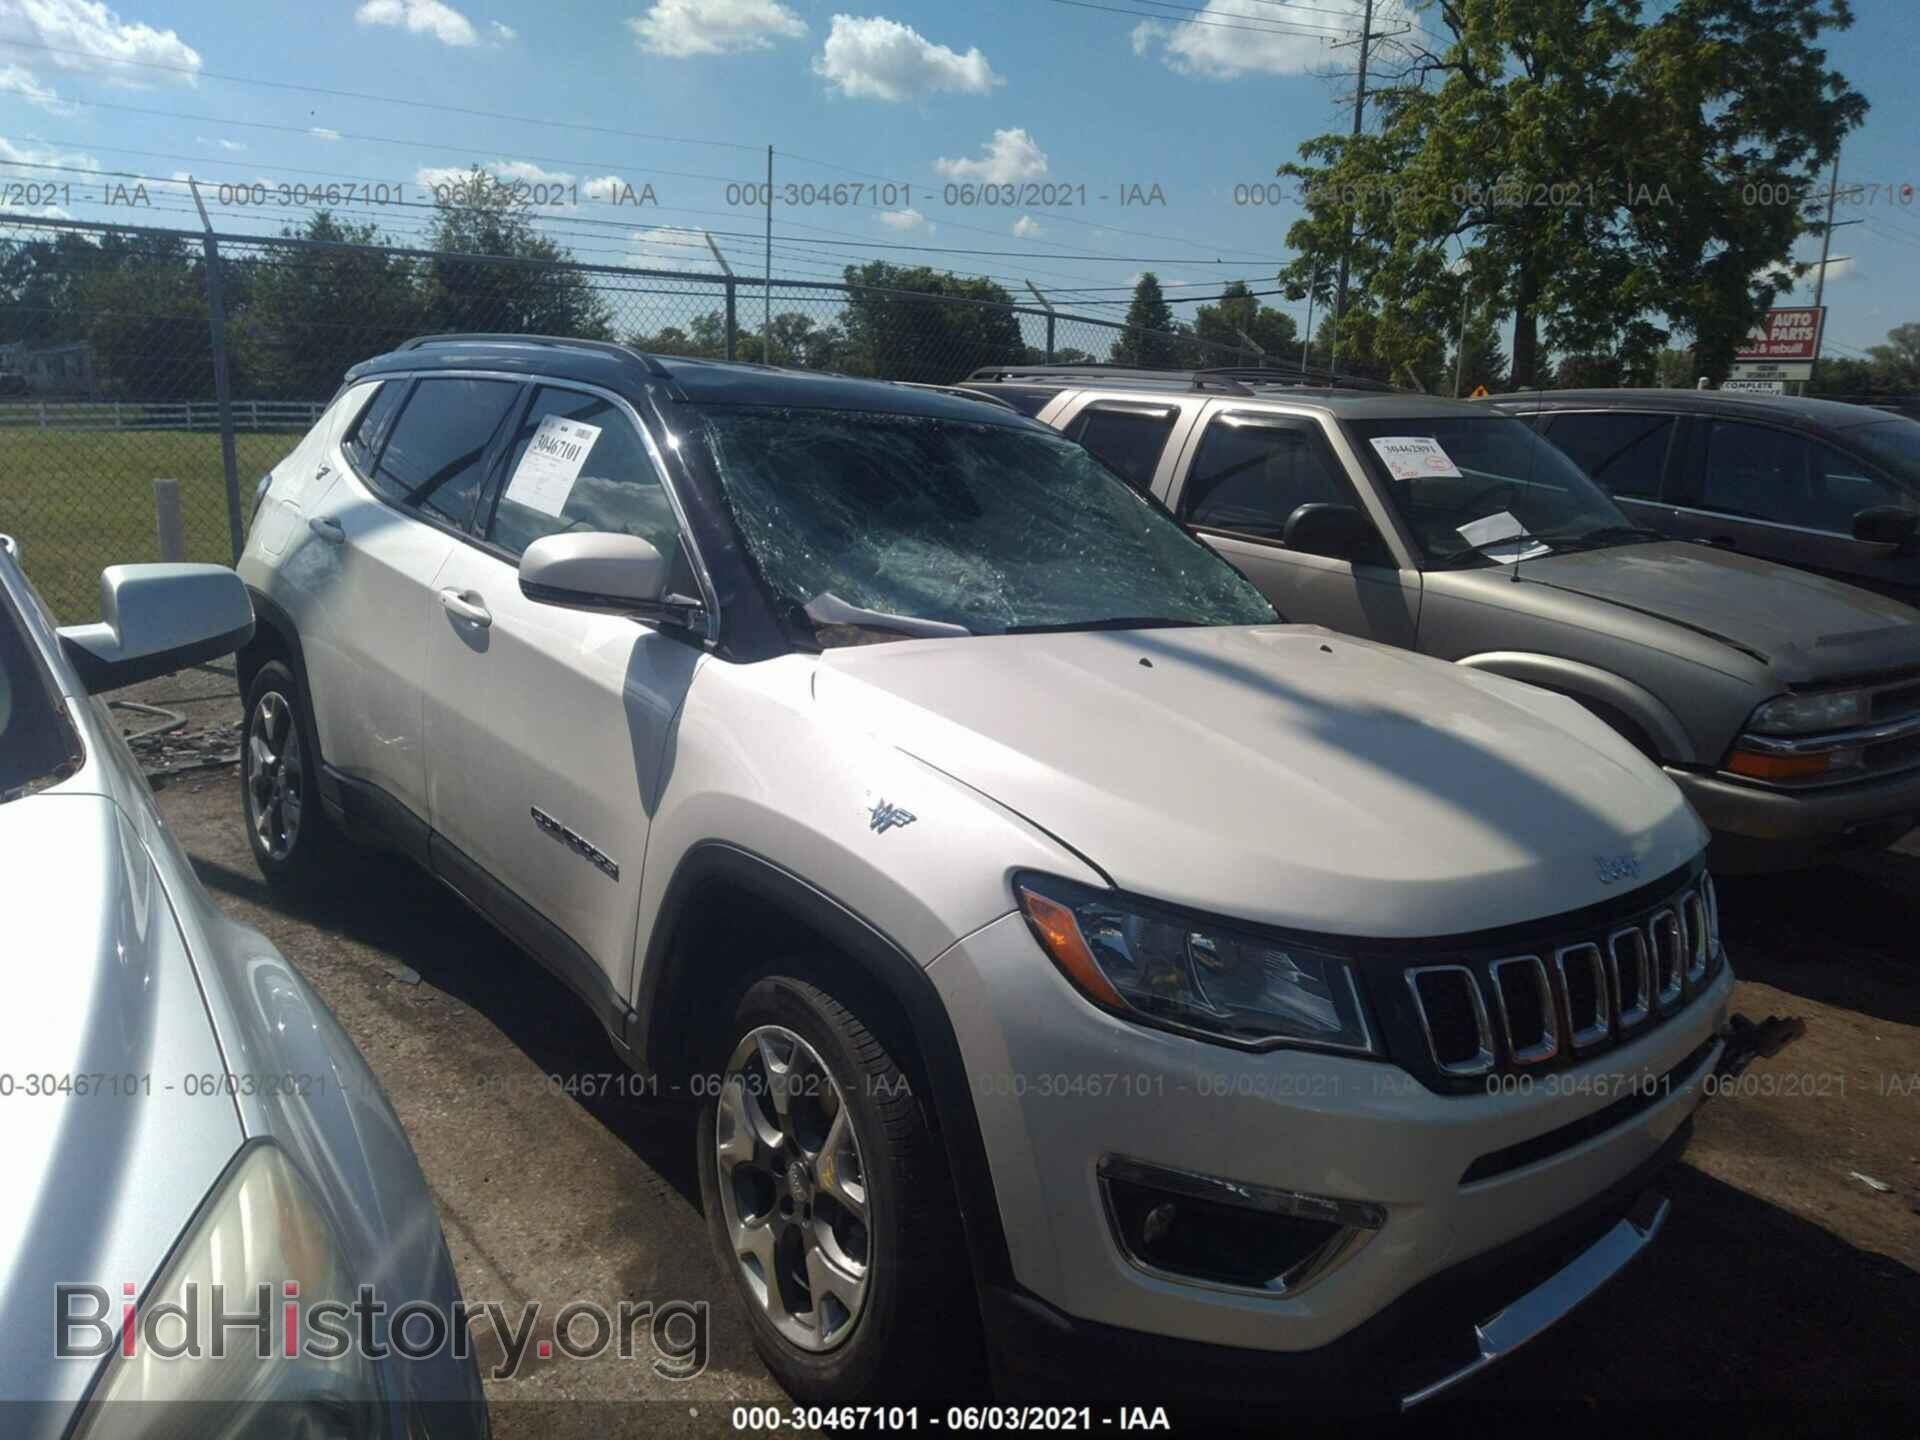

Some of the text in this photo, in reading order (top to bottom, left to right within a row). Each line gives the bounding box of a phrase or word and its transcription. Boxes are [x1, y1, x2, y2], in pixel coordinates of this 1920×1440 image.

[1773, 313, 1811, 327] AUTO
[1770, 328, 1814, 341] PARTS
[537, 434, 582, 462] 30467101
